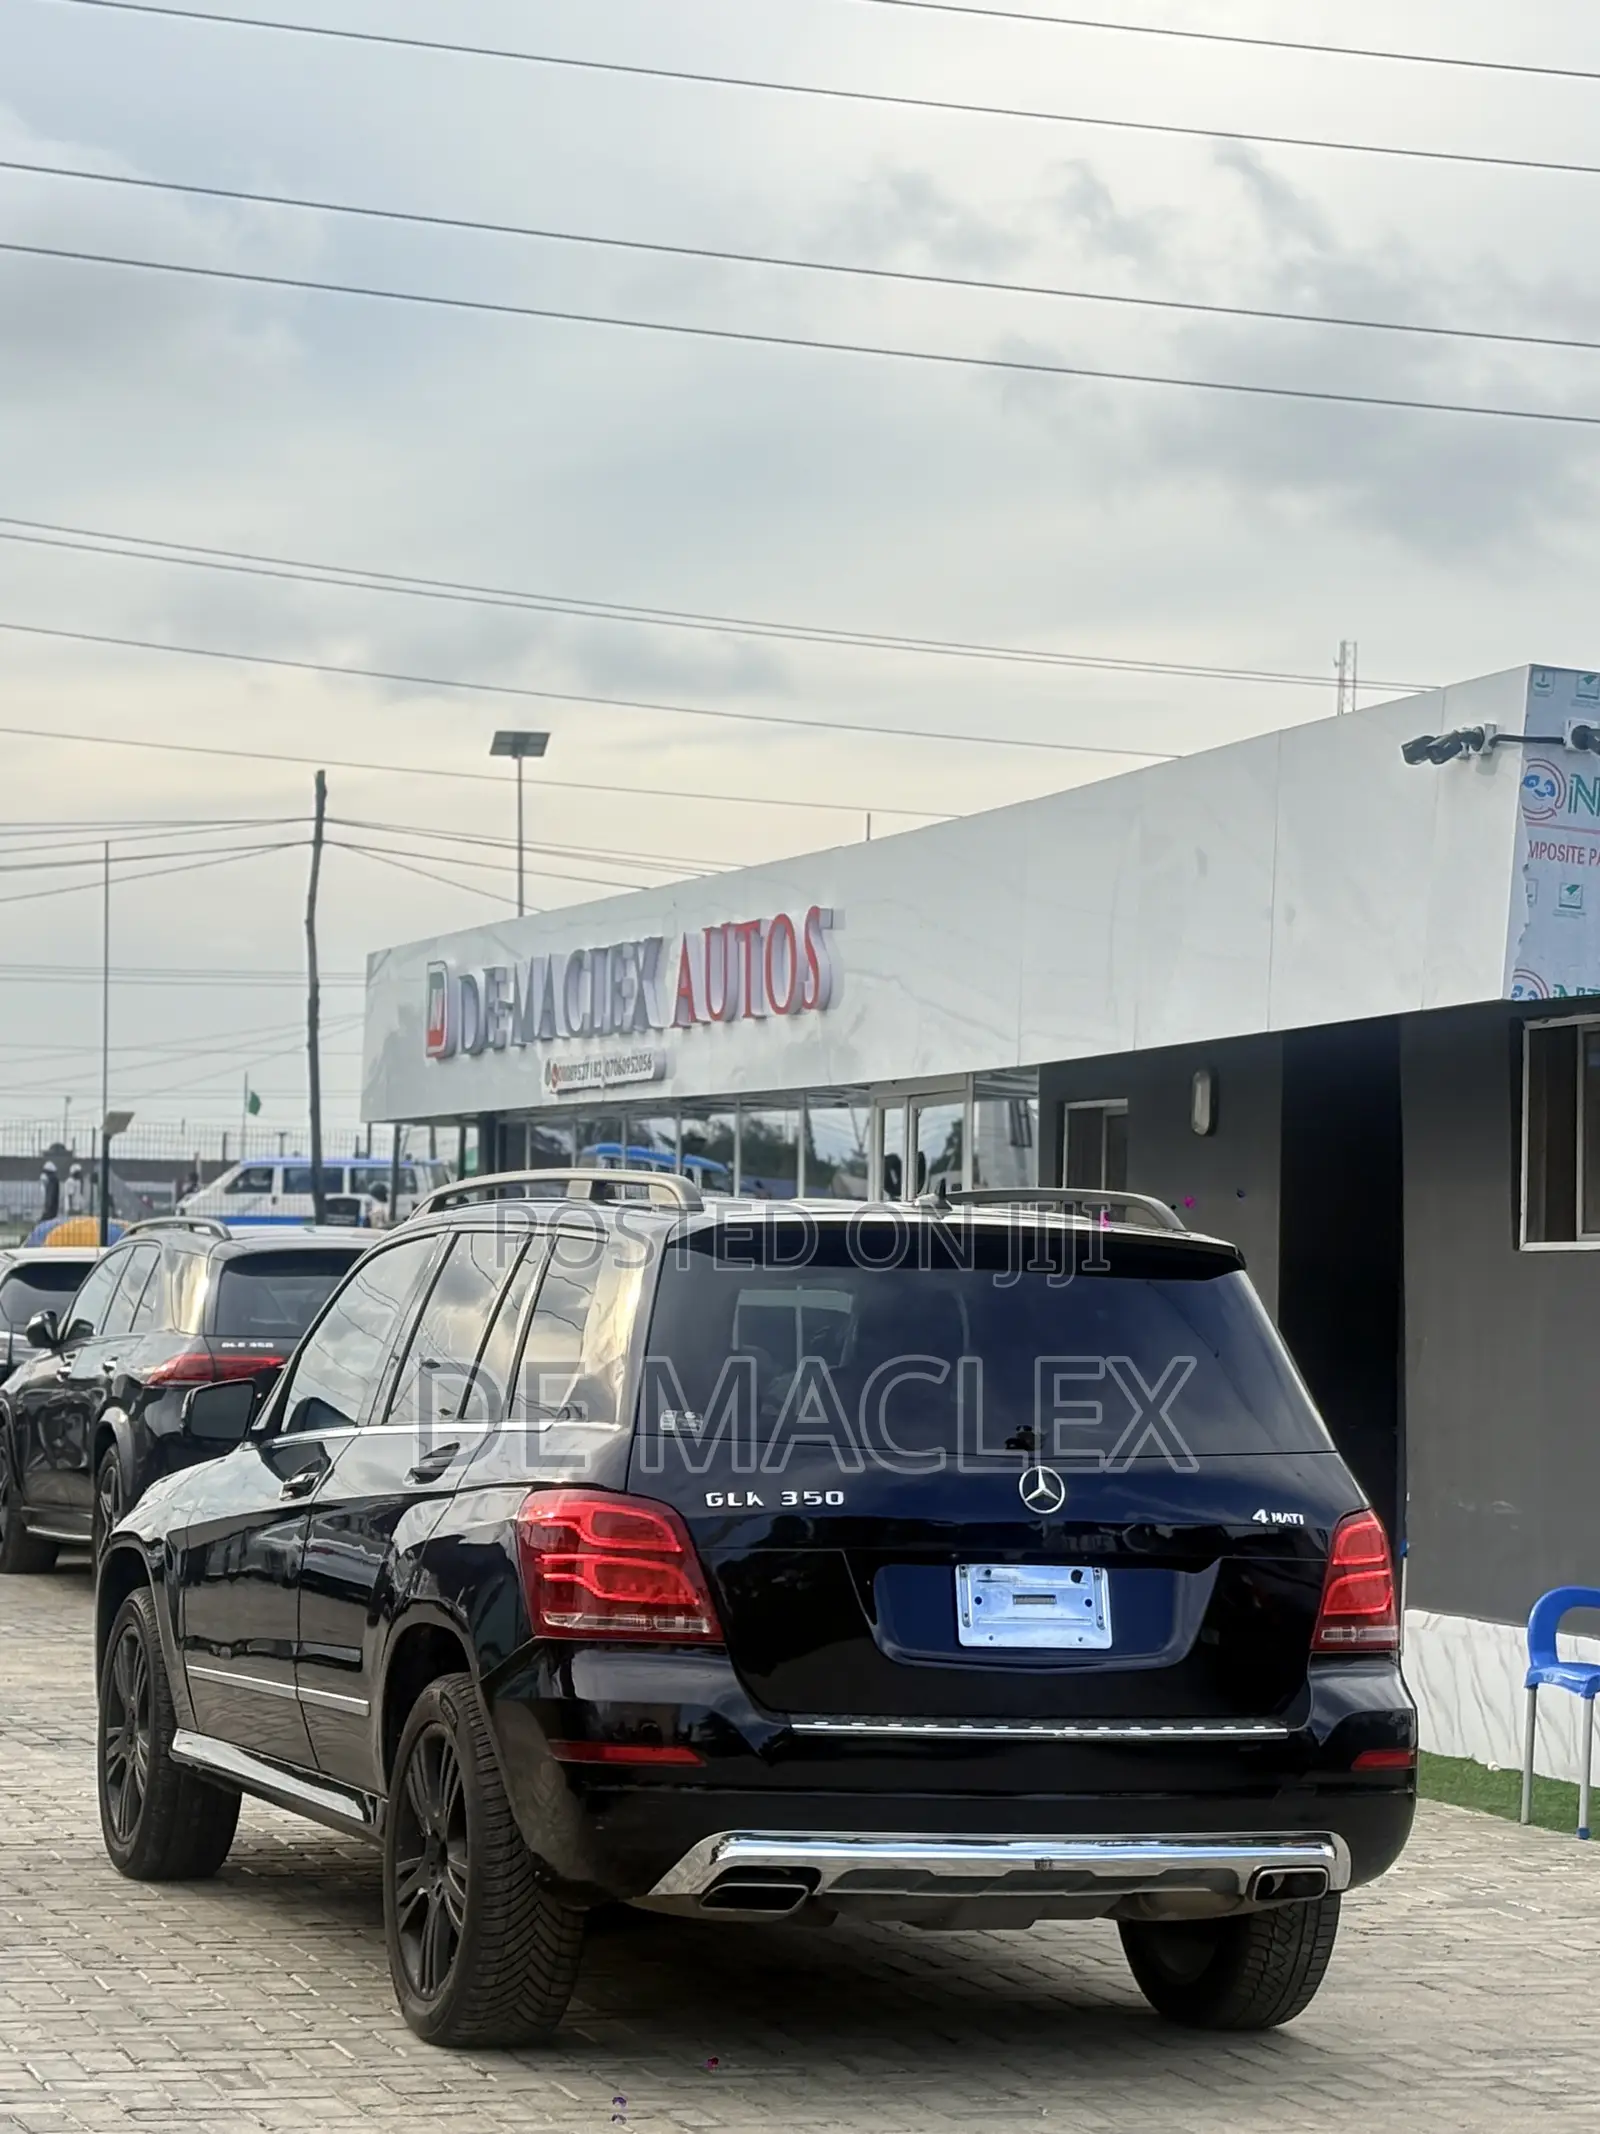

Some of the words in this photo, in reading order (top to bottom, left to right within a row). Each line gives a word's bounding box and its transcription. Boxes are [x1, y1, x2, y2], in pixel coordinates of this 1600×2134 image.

[670, 905, 835, 1028] AUTOS
[705, 1491, 765, 1507] GLK
[781, 1490, 845, 1506] 350
